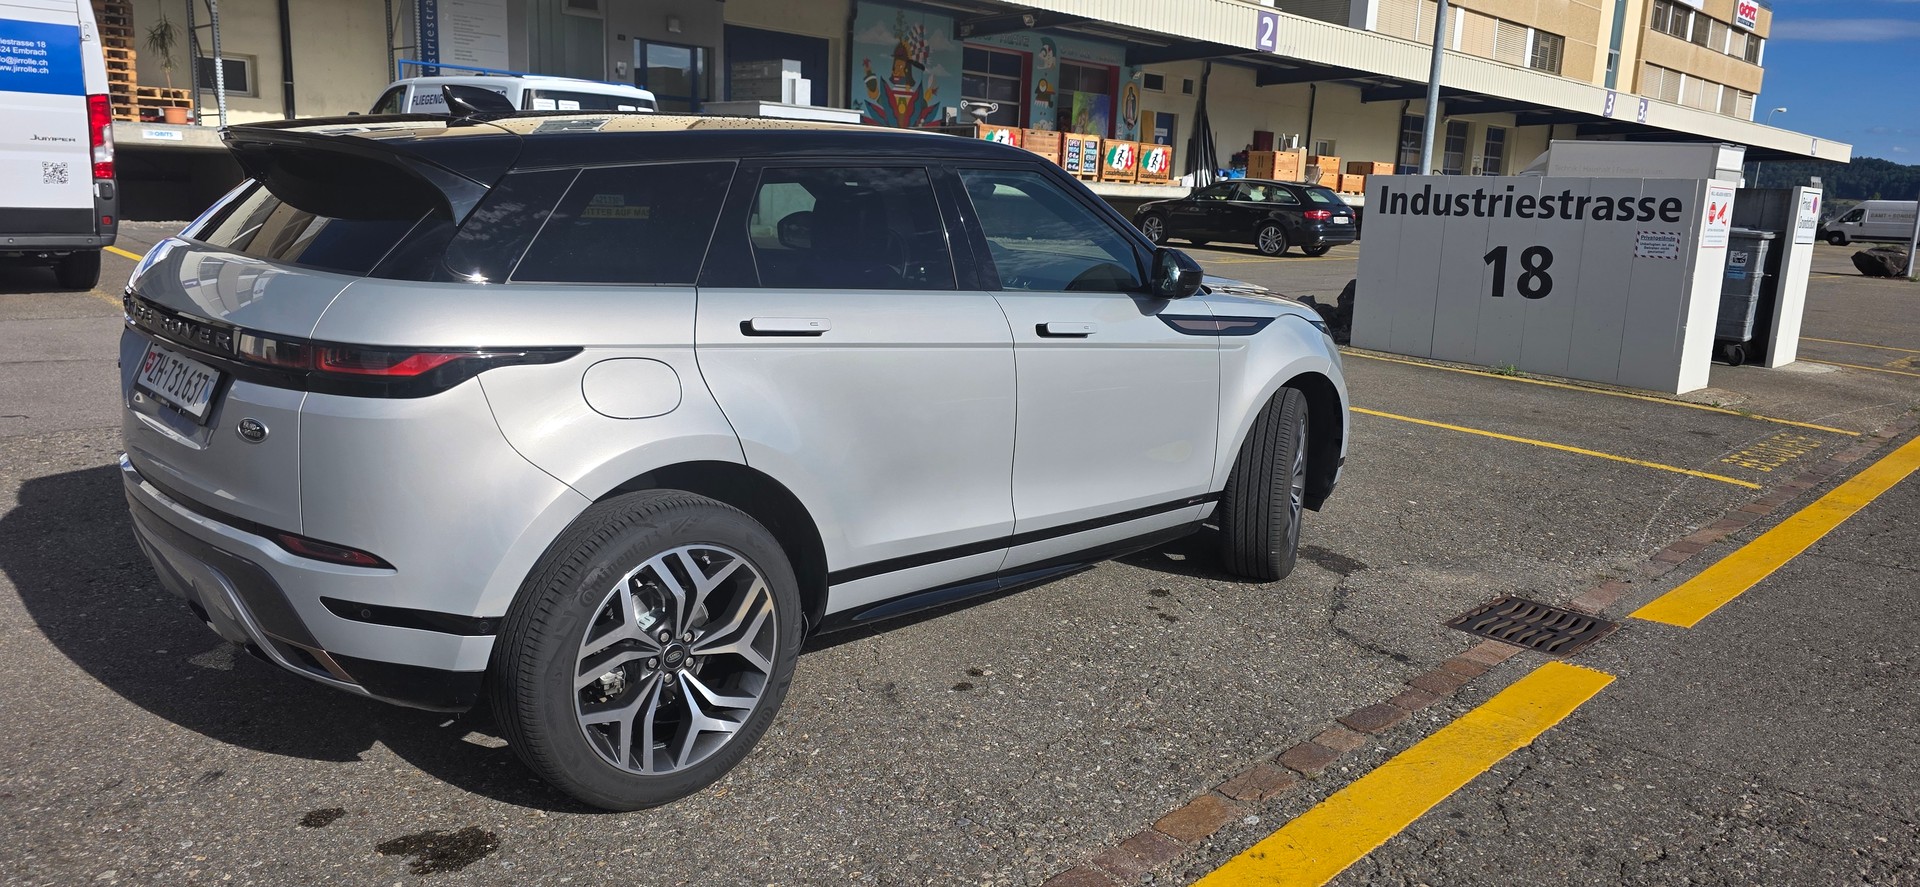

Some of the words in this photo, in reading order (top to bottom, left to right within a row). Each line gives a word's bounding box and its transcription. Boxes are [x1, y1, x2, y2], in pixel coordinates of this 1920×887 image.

[1261, 16, 1274, 47] 2
[12, 47, 47, 56] Embrach
[1606, 94, 1614, 113] 3
[1379, 184, 1683, 223] Industriestrasse
[1483, 245, 1553, 300] 18
[160, 315, 230, 350] ROVER
